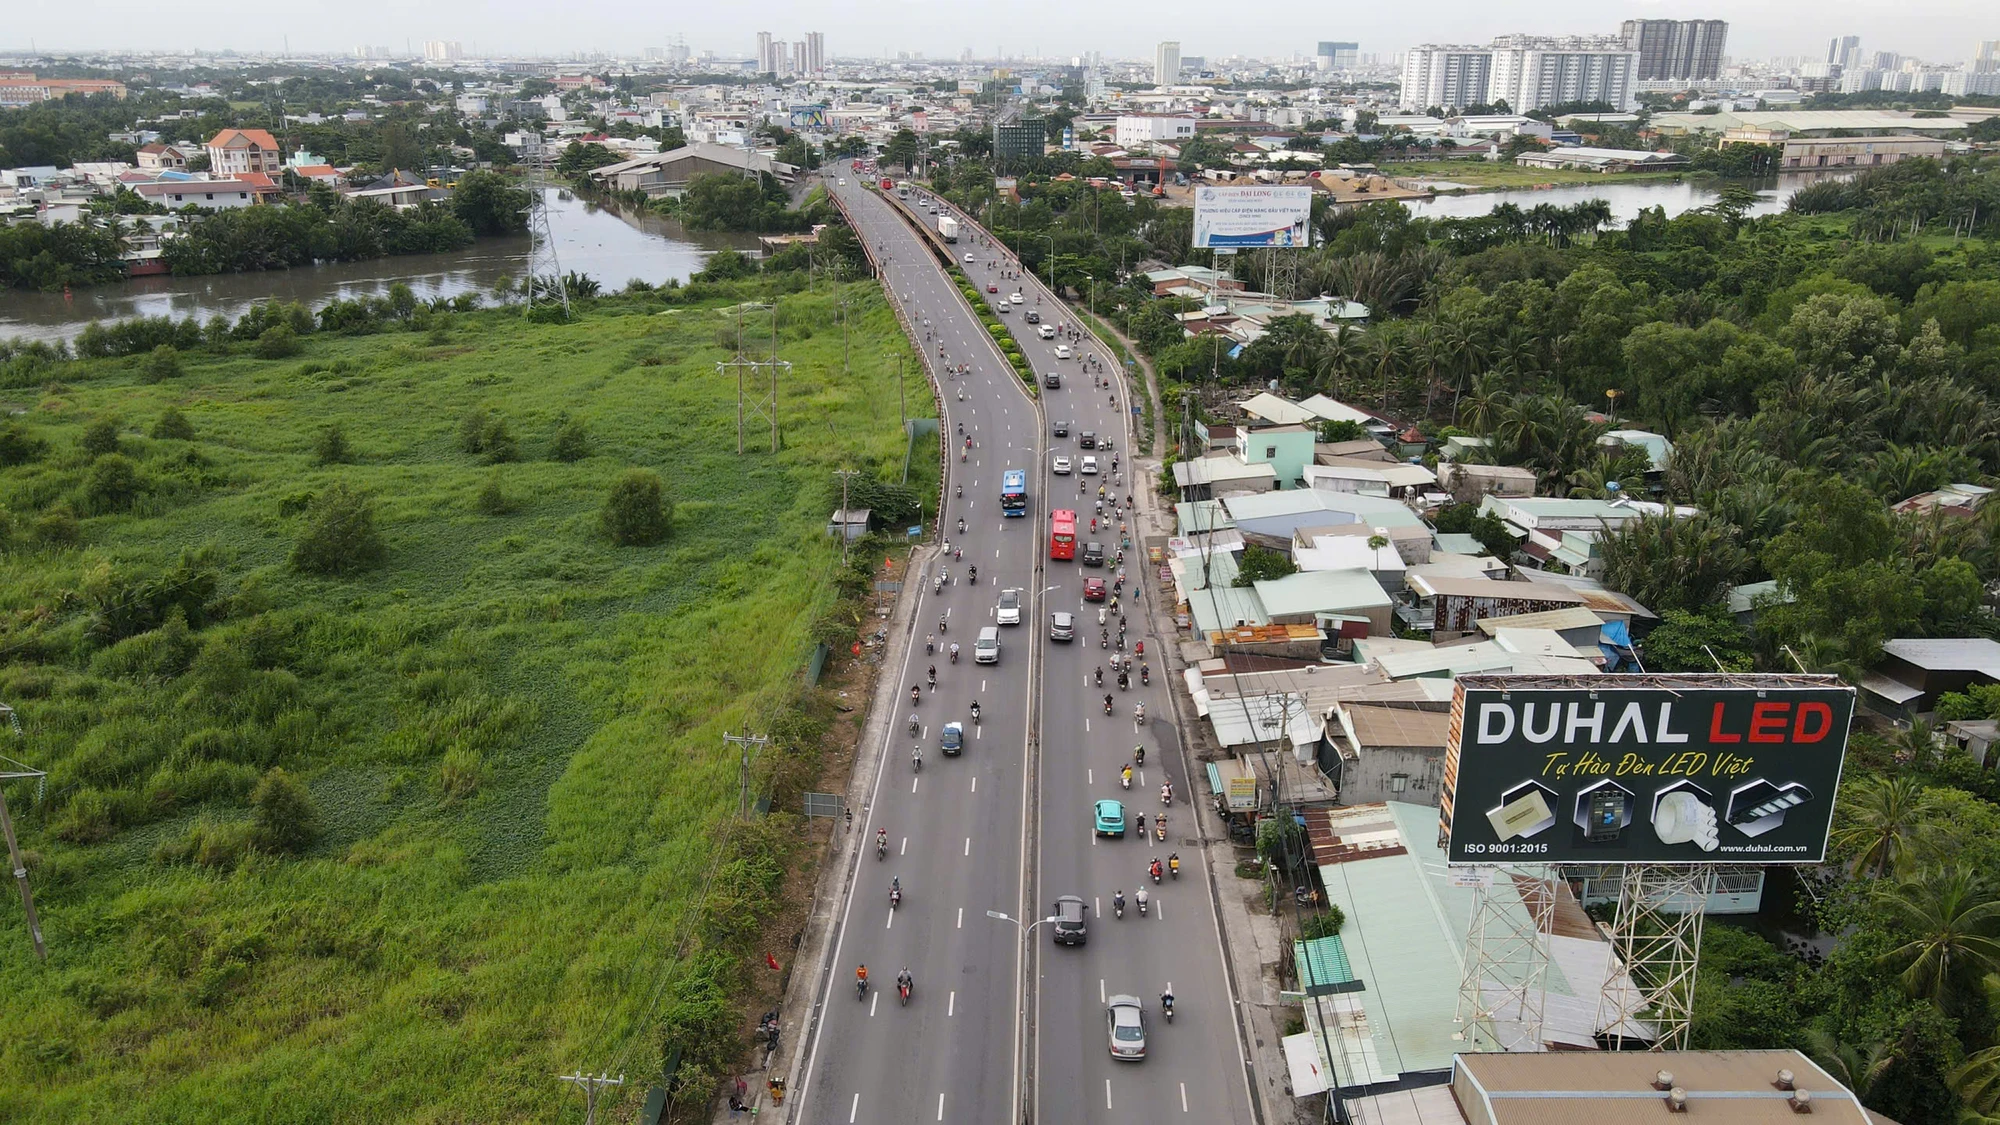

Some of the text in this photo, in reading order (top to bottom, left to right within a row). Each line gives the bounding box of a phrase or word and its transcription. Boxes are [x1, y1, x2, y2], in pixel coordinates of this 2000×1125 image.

[1477, 702, 1833, 744] DUHAL LED
[1542, 751, 1754, 780] Tự Hào Đèn LED Việt
[1464, 843, 1548, 853] ISO 9001:2015
[1720, 844, 1807, 852] www.duhal.com.vn
